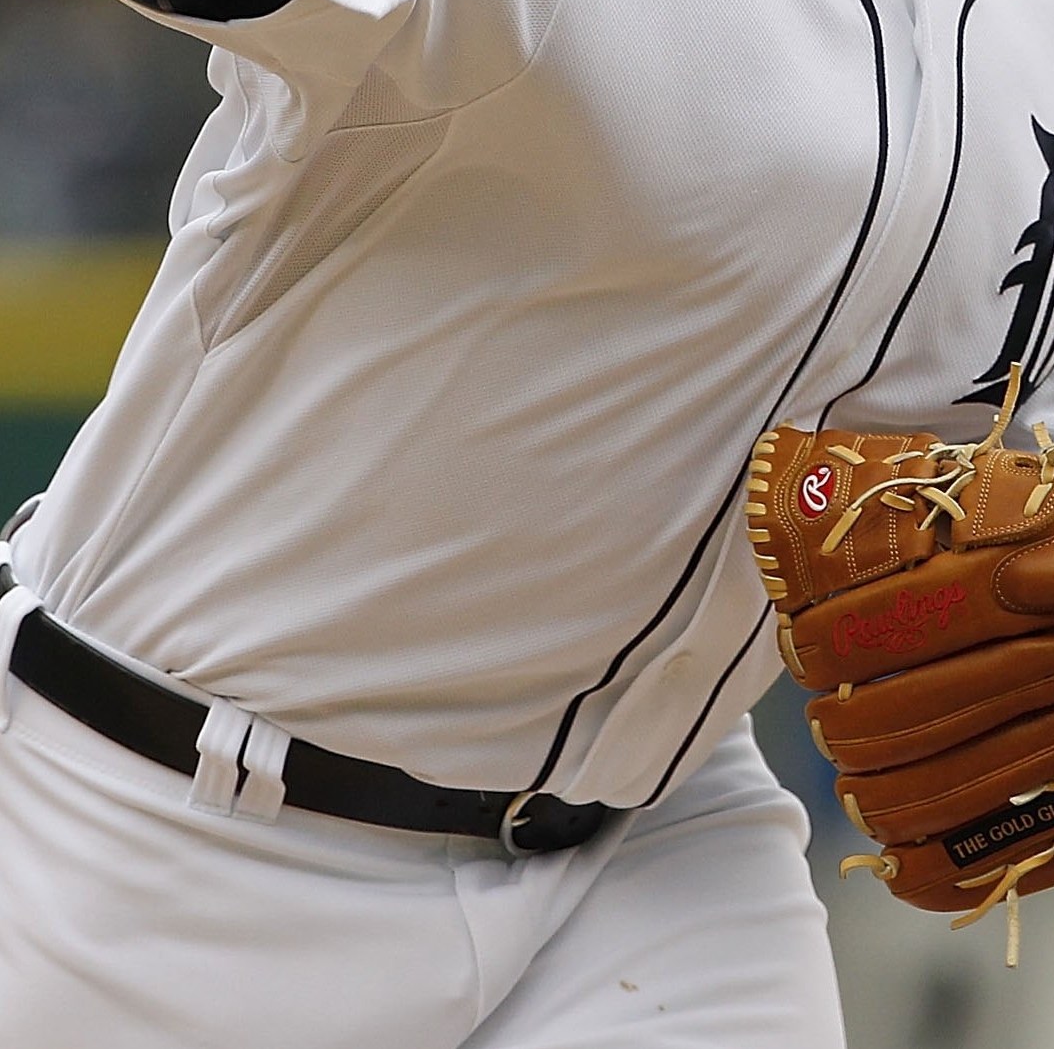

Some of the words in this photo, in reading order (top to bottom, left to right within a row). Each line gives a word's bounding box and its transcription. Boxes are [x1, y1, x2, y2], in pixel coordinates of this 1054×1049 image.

[832, 580, 967, 657] Rawlings
[953, 833, 989, 859] THE
[989, 813, 1035, 842] GOLD
